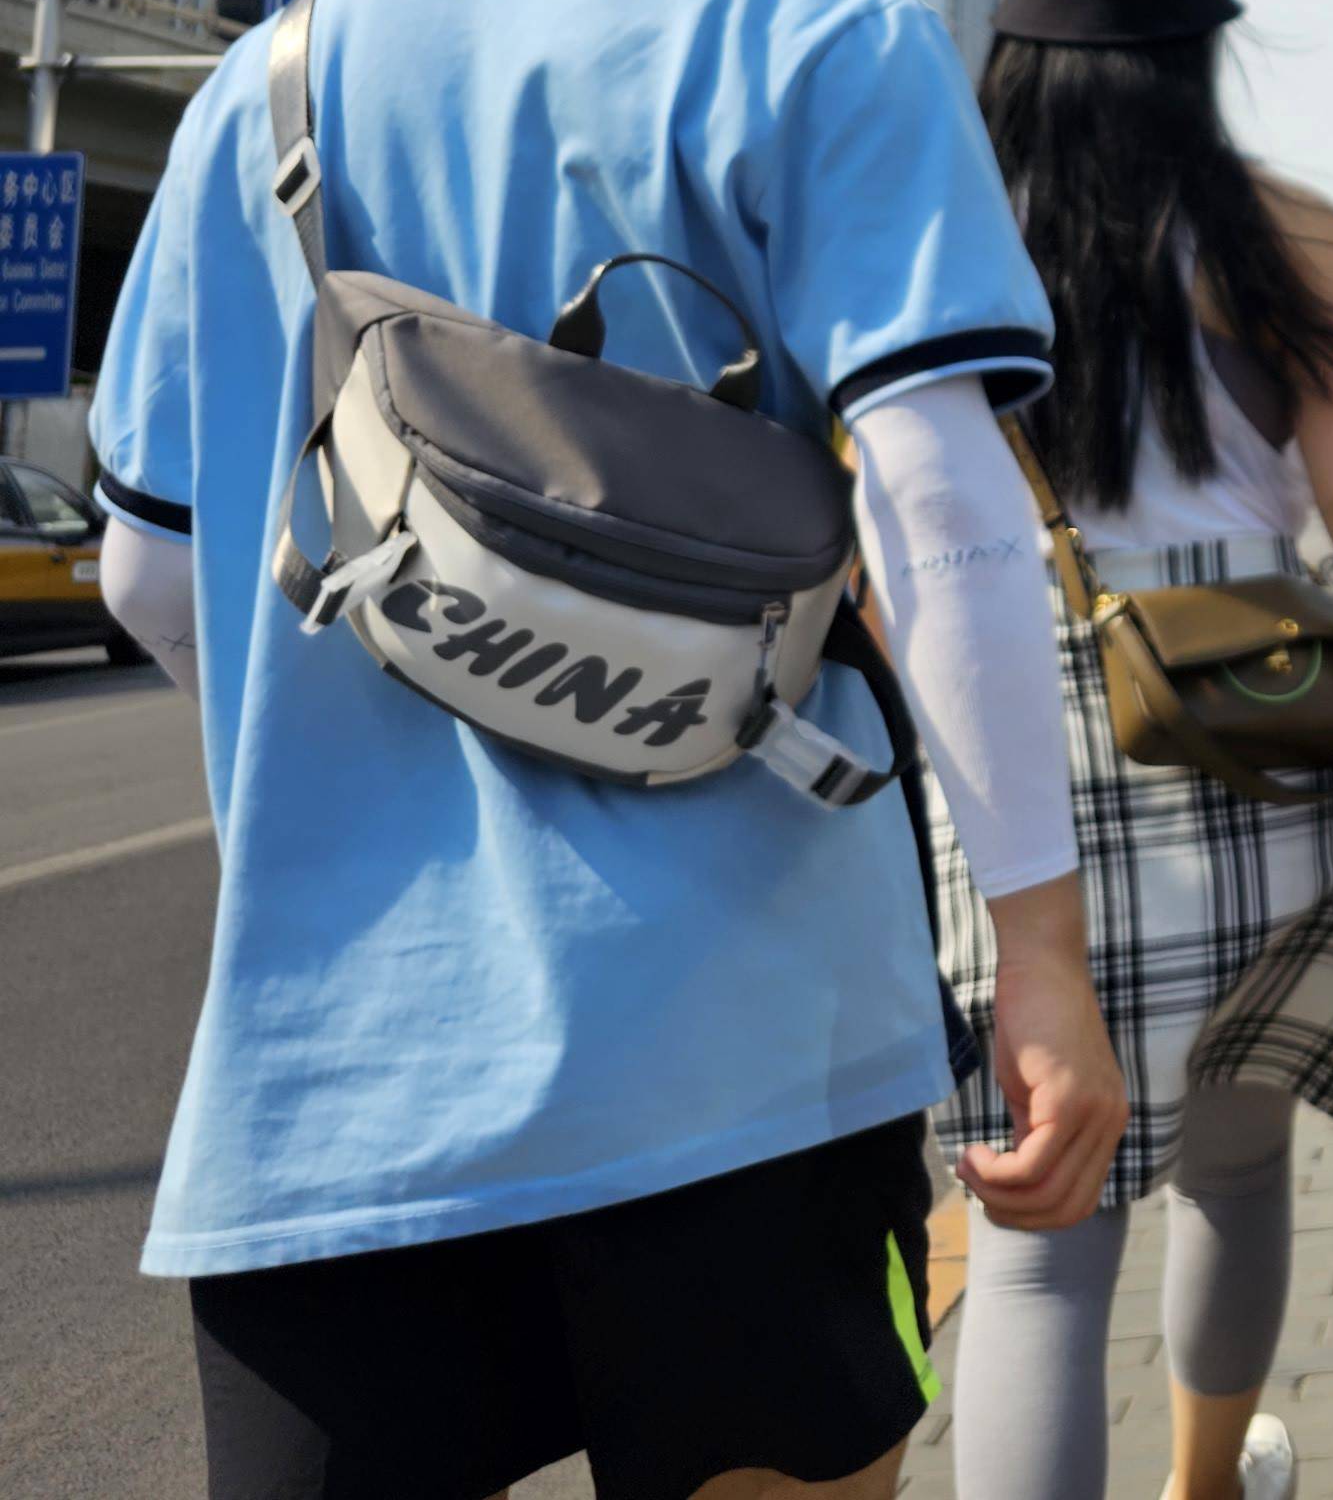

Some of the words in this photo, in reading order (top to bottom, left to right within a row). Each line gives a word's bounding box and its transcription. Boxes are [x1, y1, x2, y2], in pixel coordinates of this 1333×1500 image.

[0, 170, 76, 207] 务中心区
[381, 579, 712, 747] CHINA
